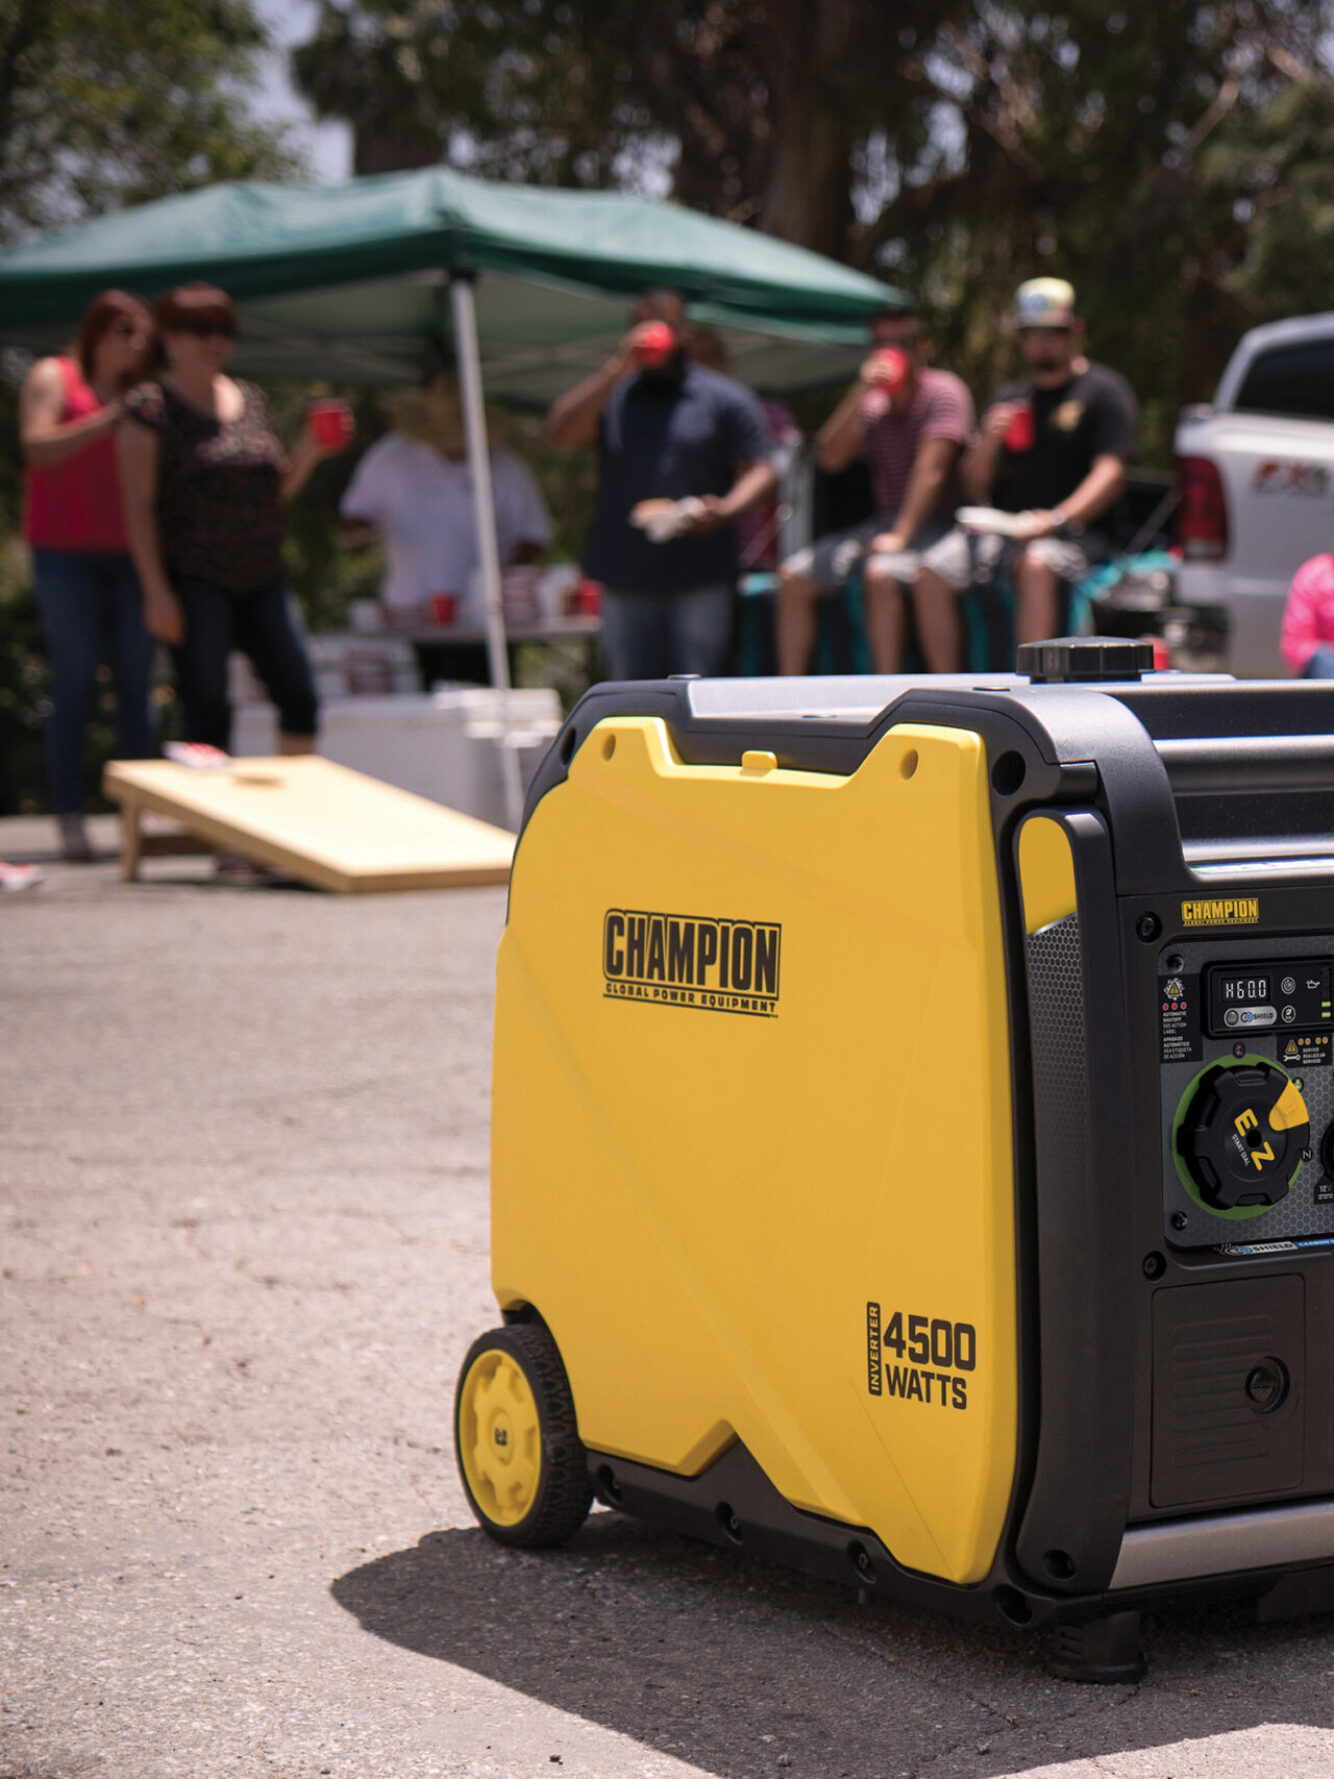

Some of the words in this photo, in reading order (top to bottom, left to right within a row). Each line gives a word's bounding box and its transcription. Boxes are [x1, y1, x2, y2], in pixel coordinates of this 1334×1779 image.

[1183, 899, 1257, 919] CHAMPION
[605, 914, 778, 995] CHAMPION
[605, 983, 649, 998] GLOBAL
[653, 987, 695, 1003] POWER
[701, 994, 776, 1013] EQUIPMENT
[1253, 1242, 1293, 1251] SHIELD
[868, 1306, 880, 1391] INVERTER
[883, 1311, 976, 1372] 4500
[885, 1363, 967, 1410] WATTS
